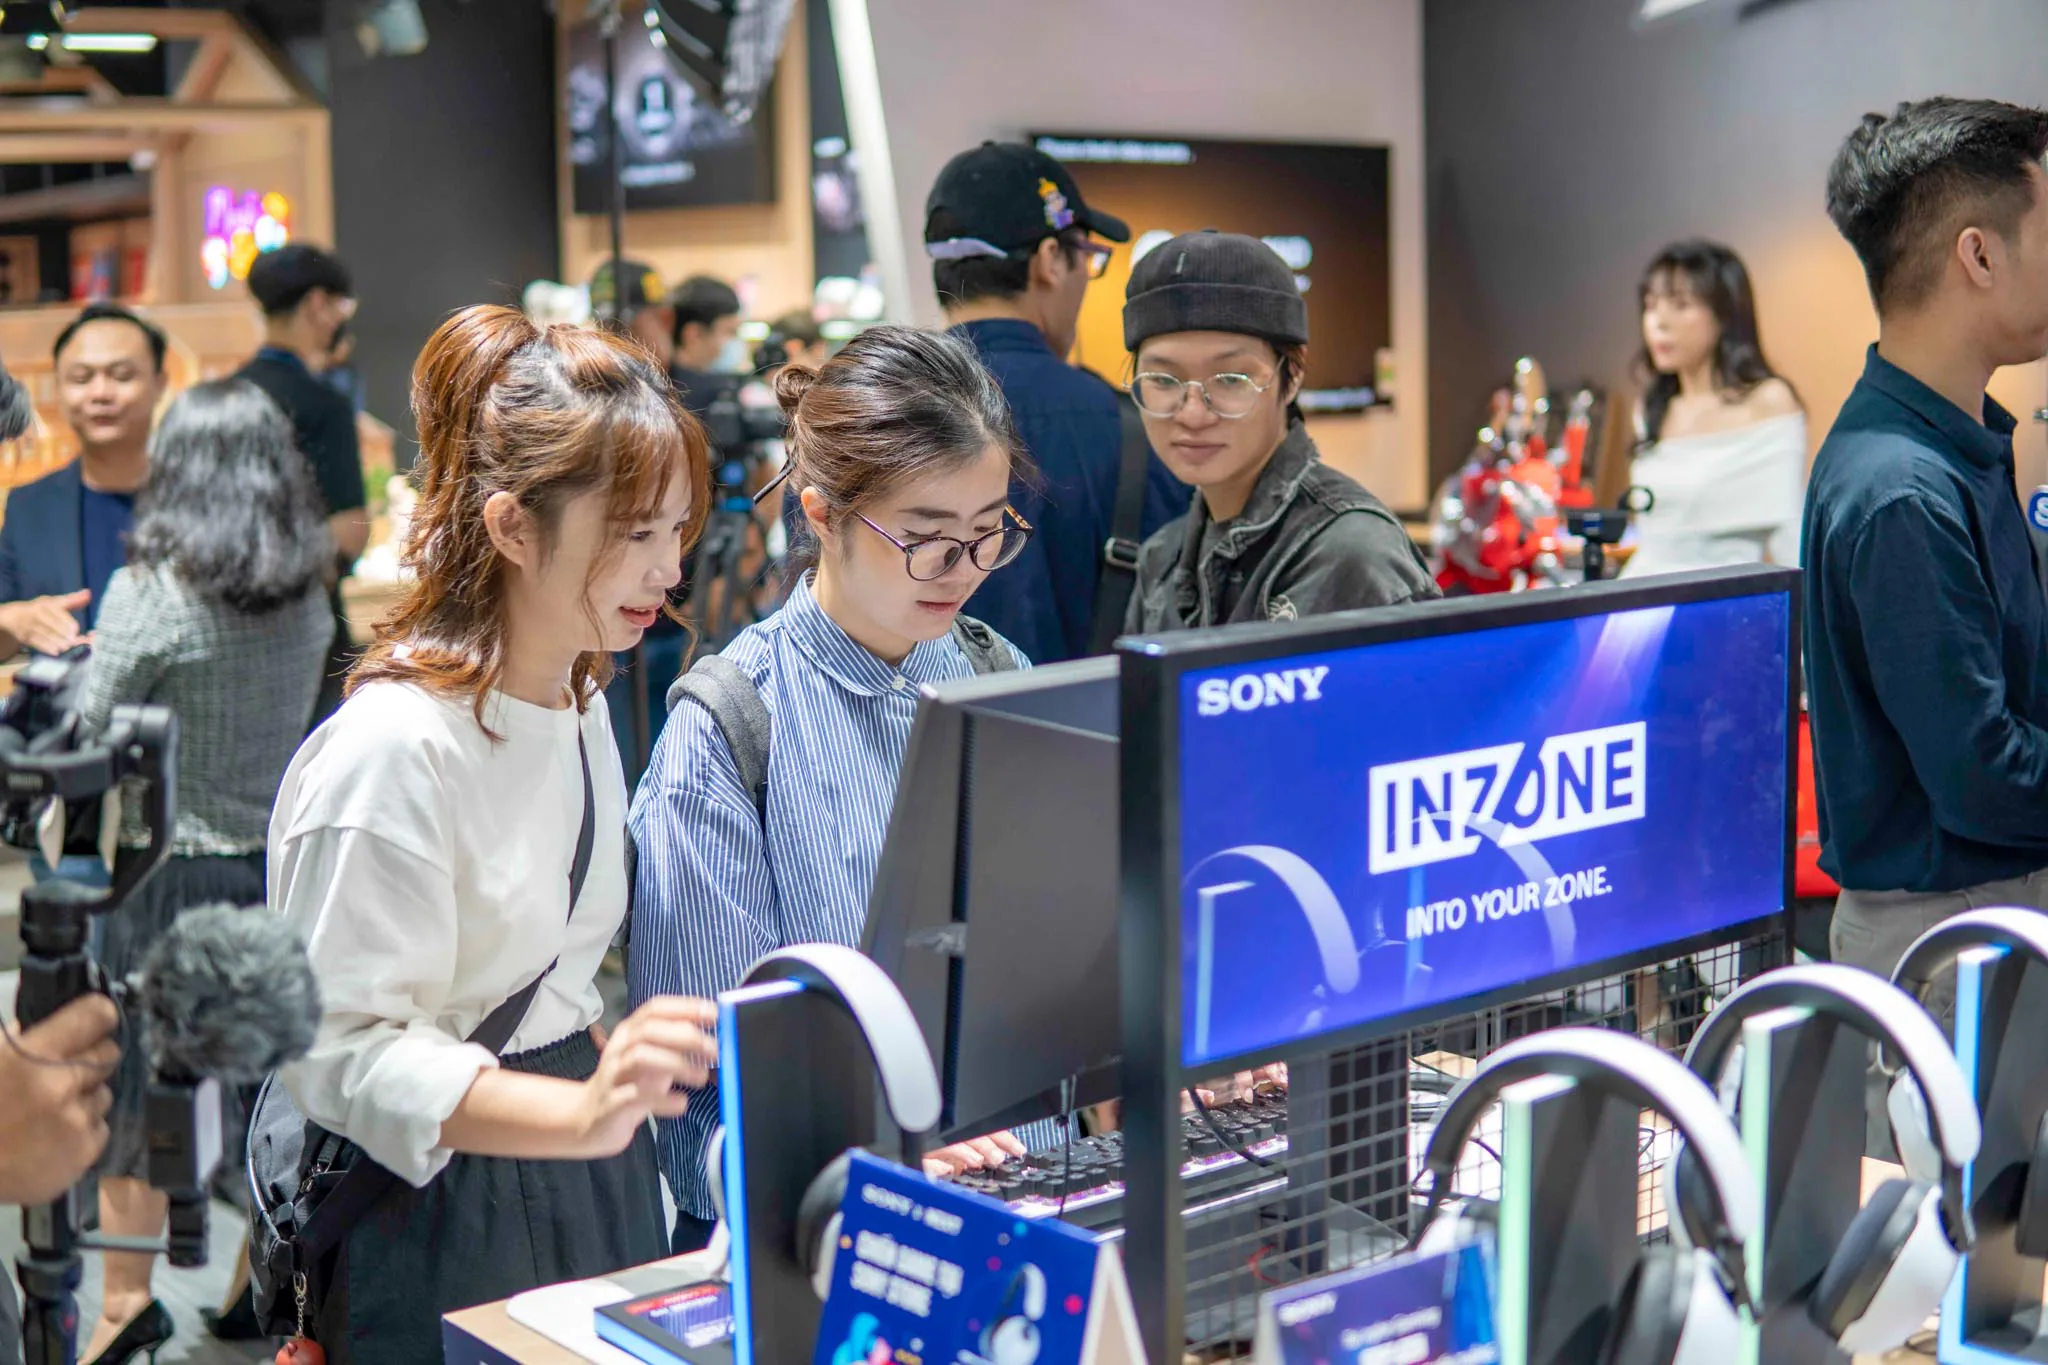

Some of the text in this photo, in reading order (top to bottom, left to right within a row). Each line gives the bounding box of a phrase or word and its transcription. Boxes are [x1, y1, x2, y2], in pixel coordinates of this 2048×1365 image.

[1197, 665, 1330, 717] SONY
[1382, 732, 1638, 856] INZONE
[1406, 865, 1613, 940] INTO YOUR ZONE.
